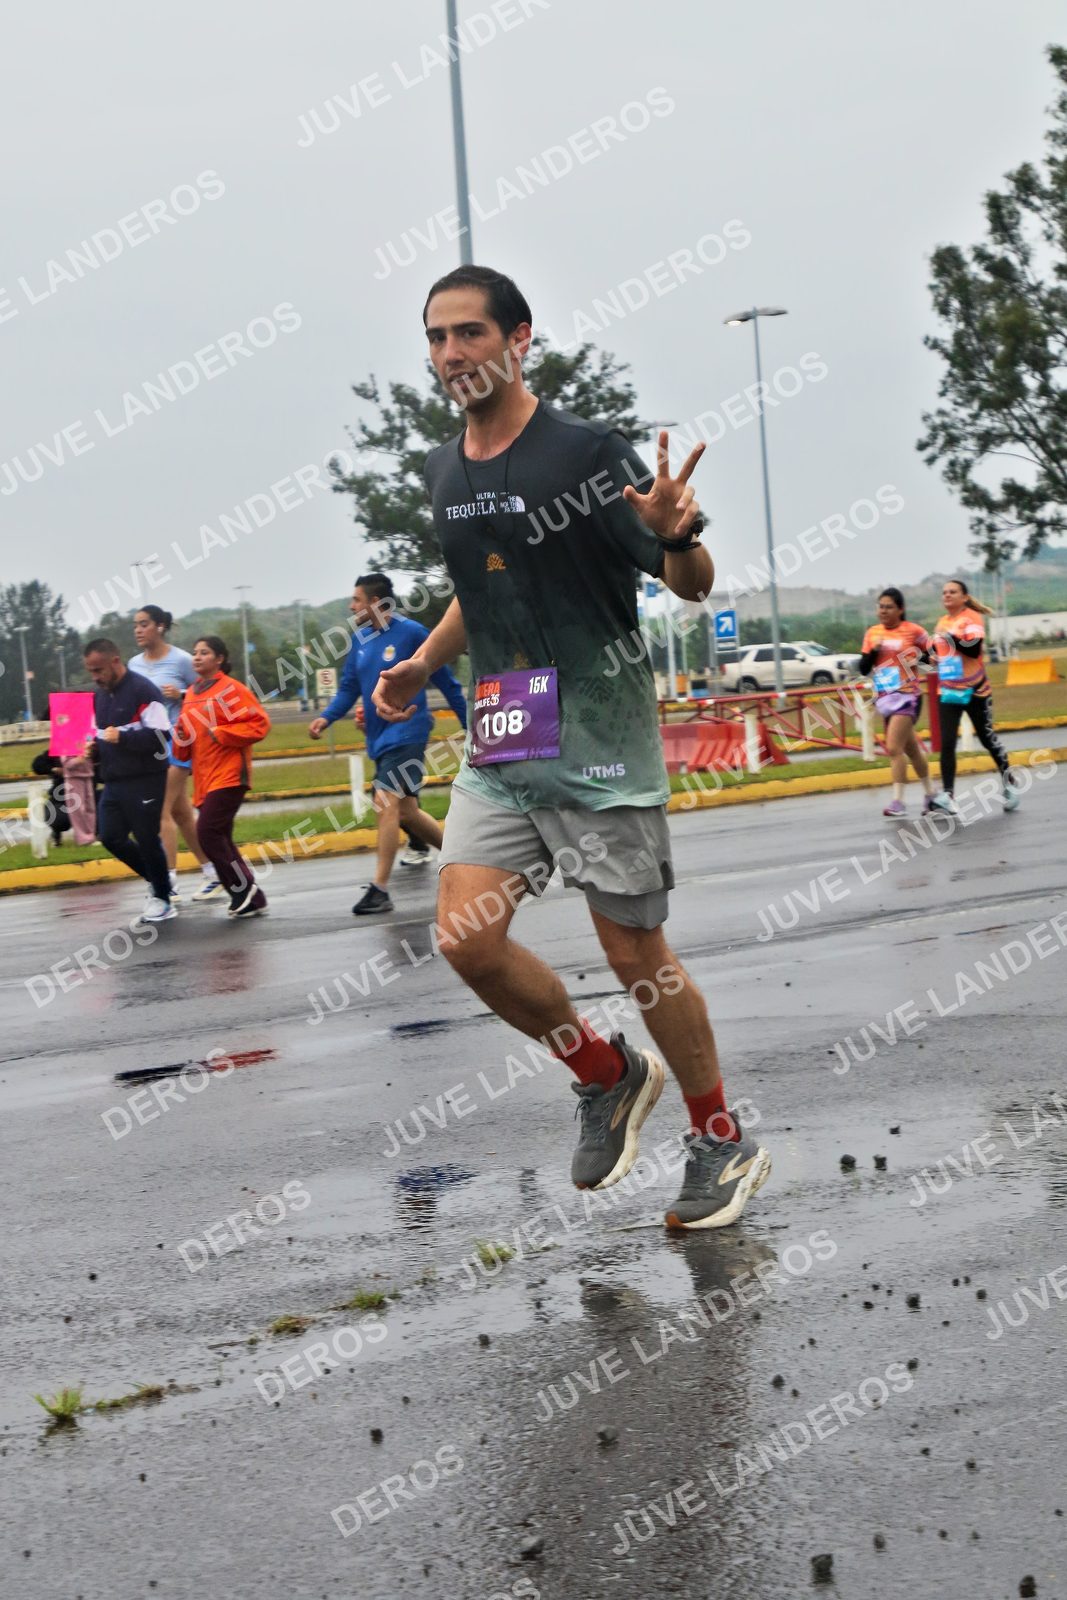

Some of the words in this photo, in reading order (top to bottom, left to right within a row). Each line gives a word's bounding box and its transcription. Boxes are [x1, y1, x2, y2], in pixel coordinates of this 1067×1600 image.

[476, 491, 496, 500] ULTRA
[445, 500, 496, 520] TEQUILA
[529, 676, 549, 694] 15K
[481, 709, 523, 738] 108
[582, 763, 626, 780] UTMS
